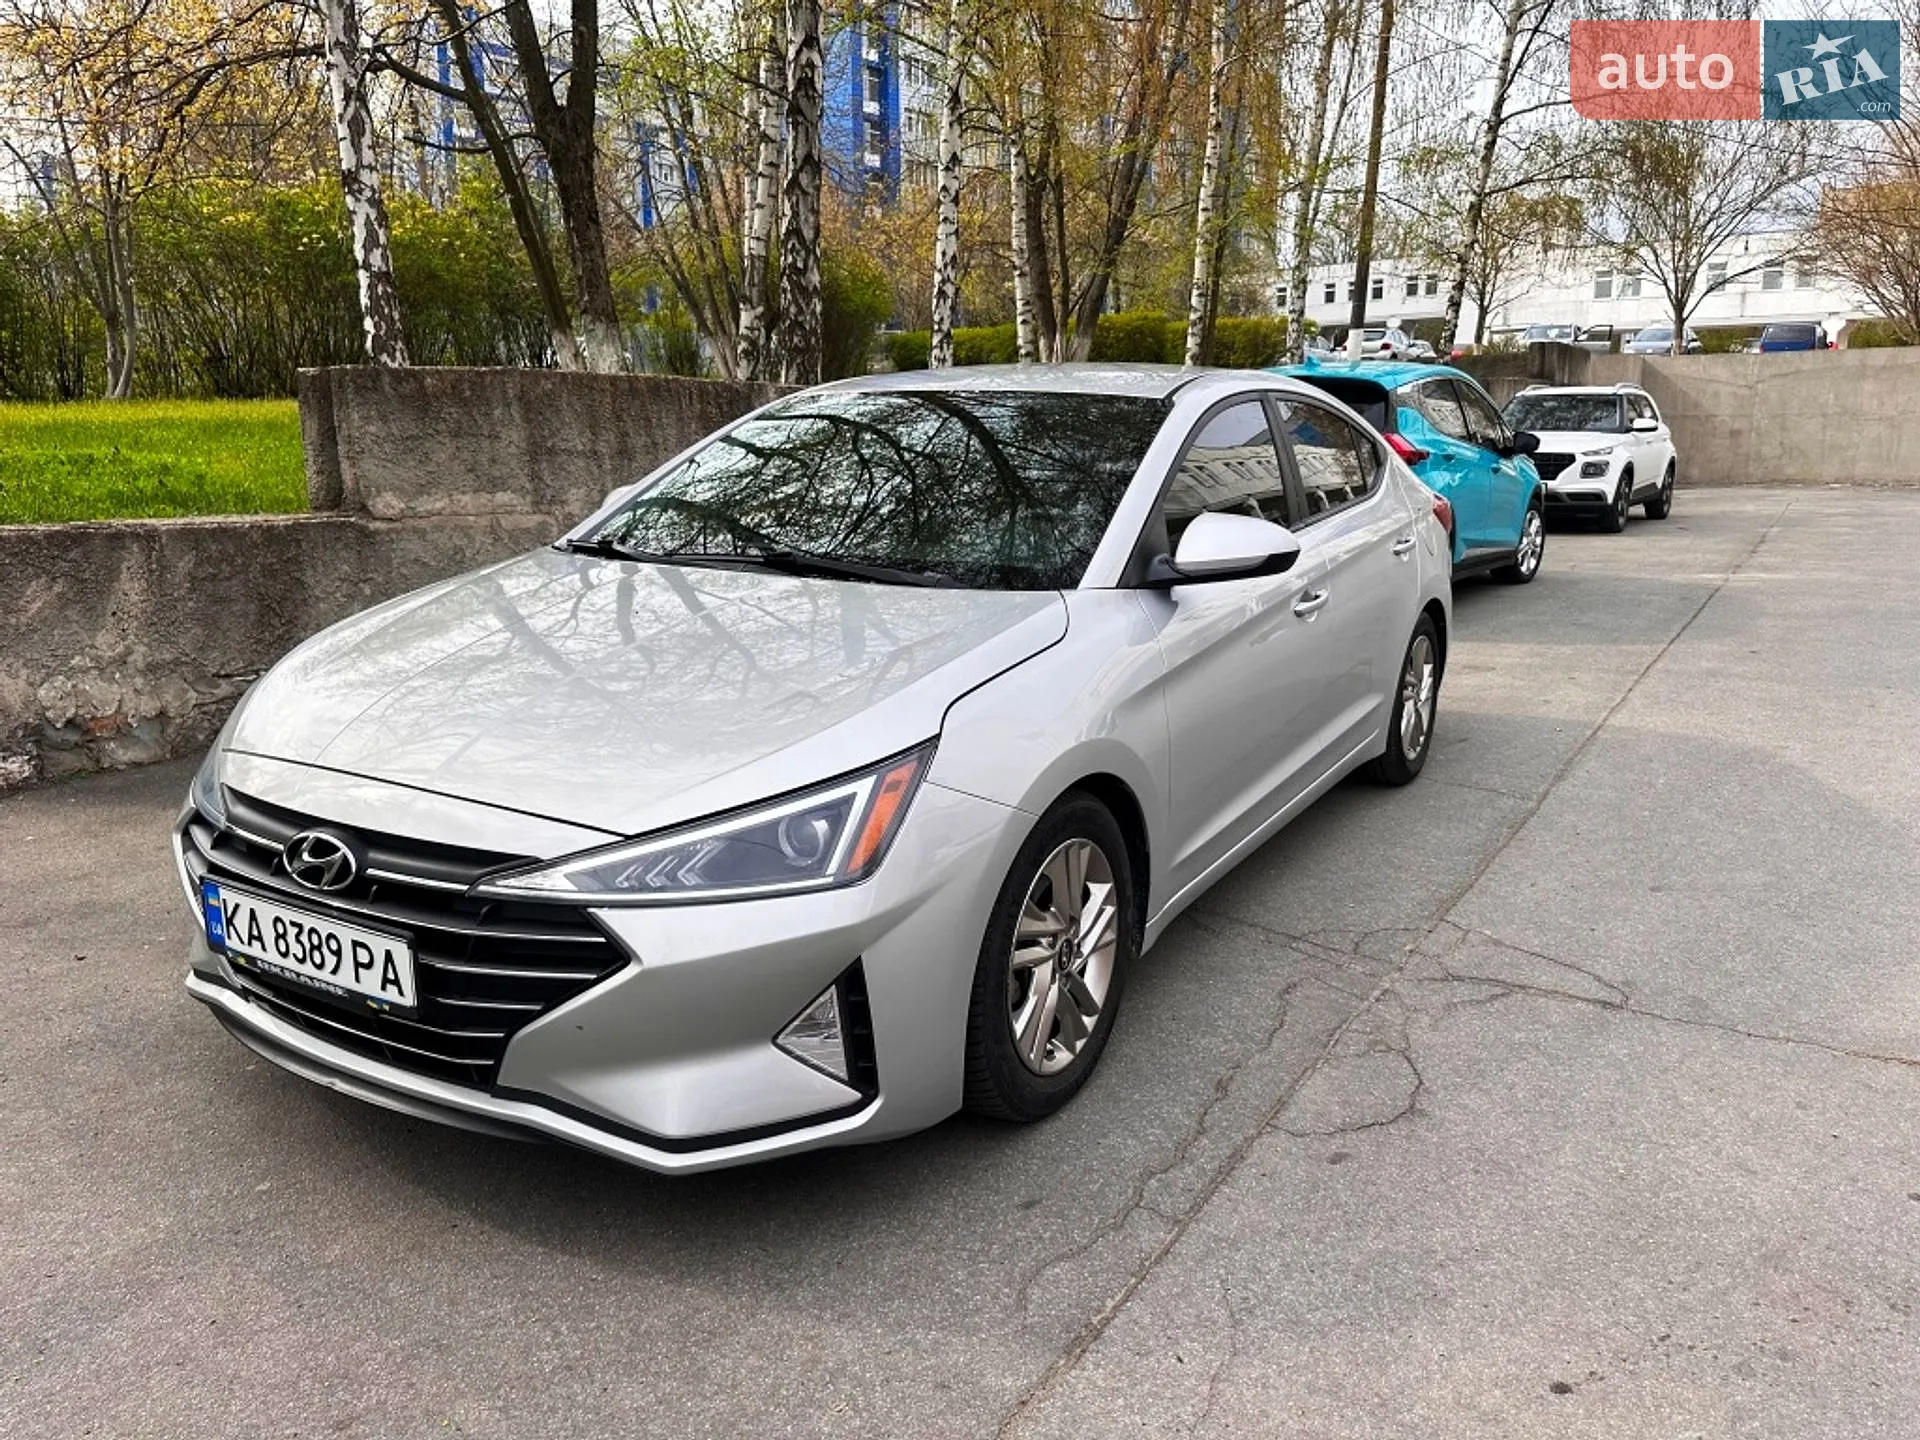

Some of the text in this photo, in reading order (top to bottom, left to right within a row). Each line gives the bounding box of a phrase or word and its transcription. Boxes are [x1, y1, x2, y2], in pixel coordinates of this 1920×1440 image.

[221, 898, 267, 952] KA
[272, 915, 342, 976] 8389
[351, 938, 404, 997] PA
